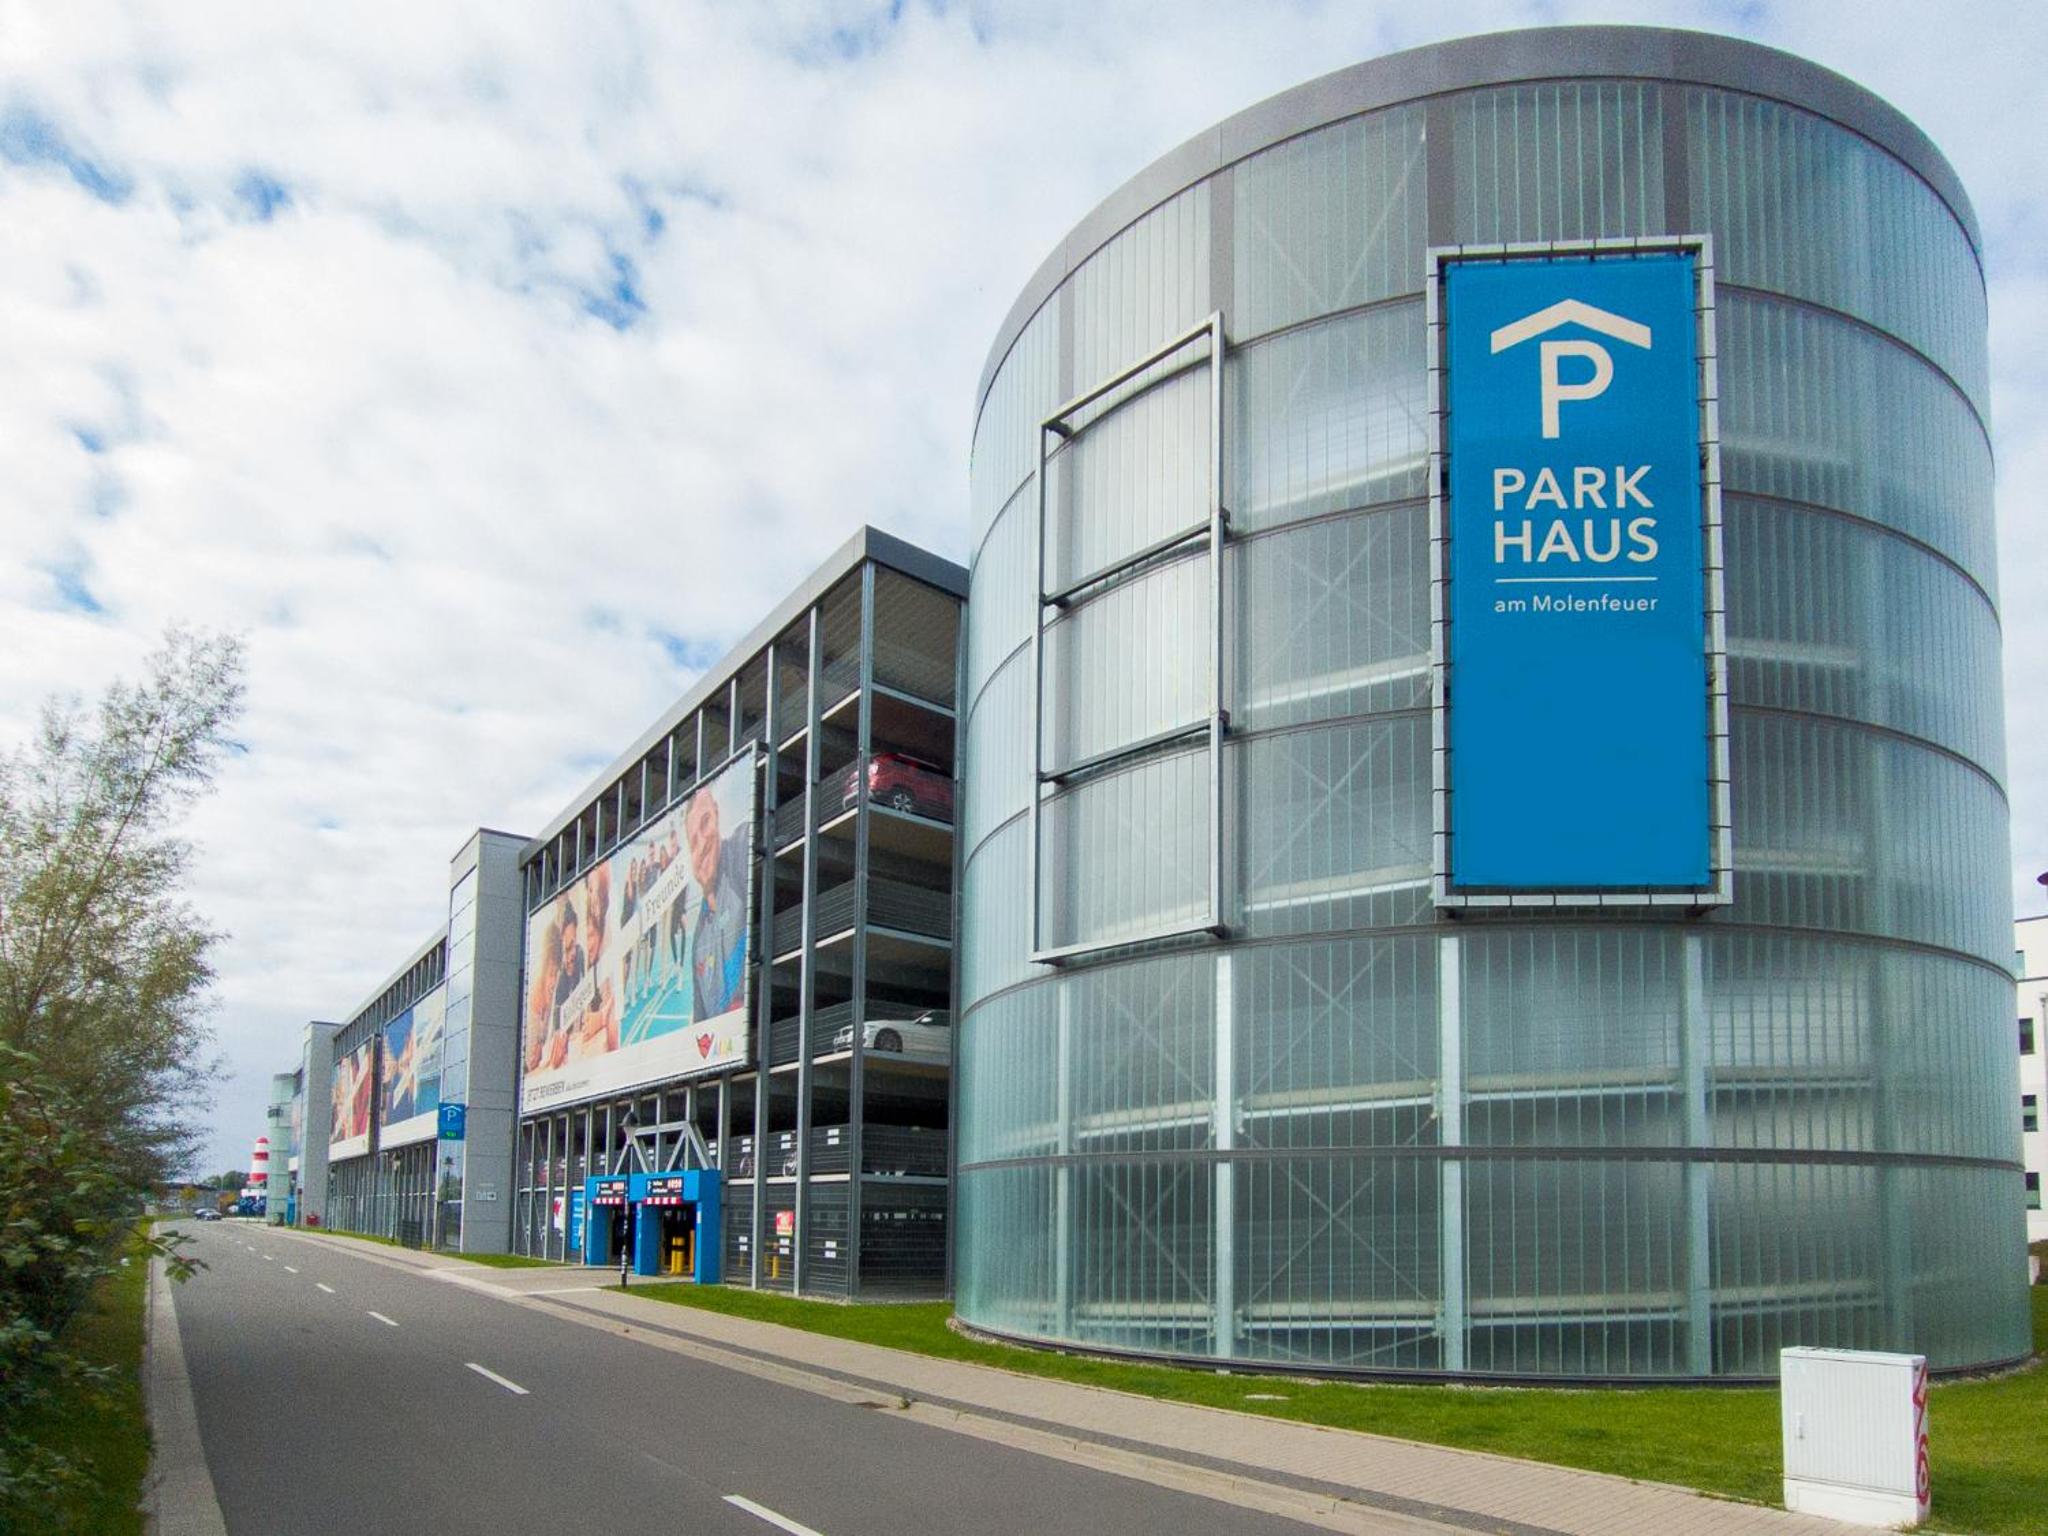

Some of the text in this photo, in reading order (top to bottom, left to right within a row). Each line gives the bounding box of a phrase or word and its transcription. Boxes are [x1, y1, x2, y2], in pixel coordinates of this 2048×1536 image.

[1540, 340, 1614, 439] P
[1494, 465, 1655, 511] PARK
[1494, 517, 1659, 563] HAUS
[1494, 594, 1658, 612] am Molenfeuer
